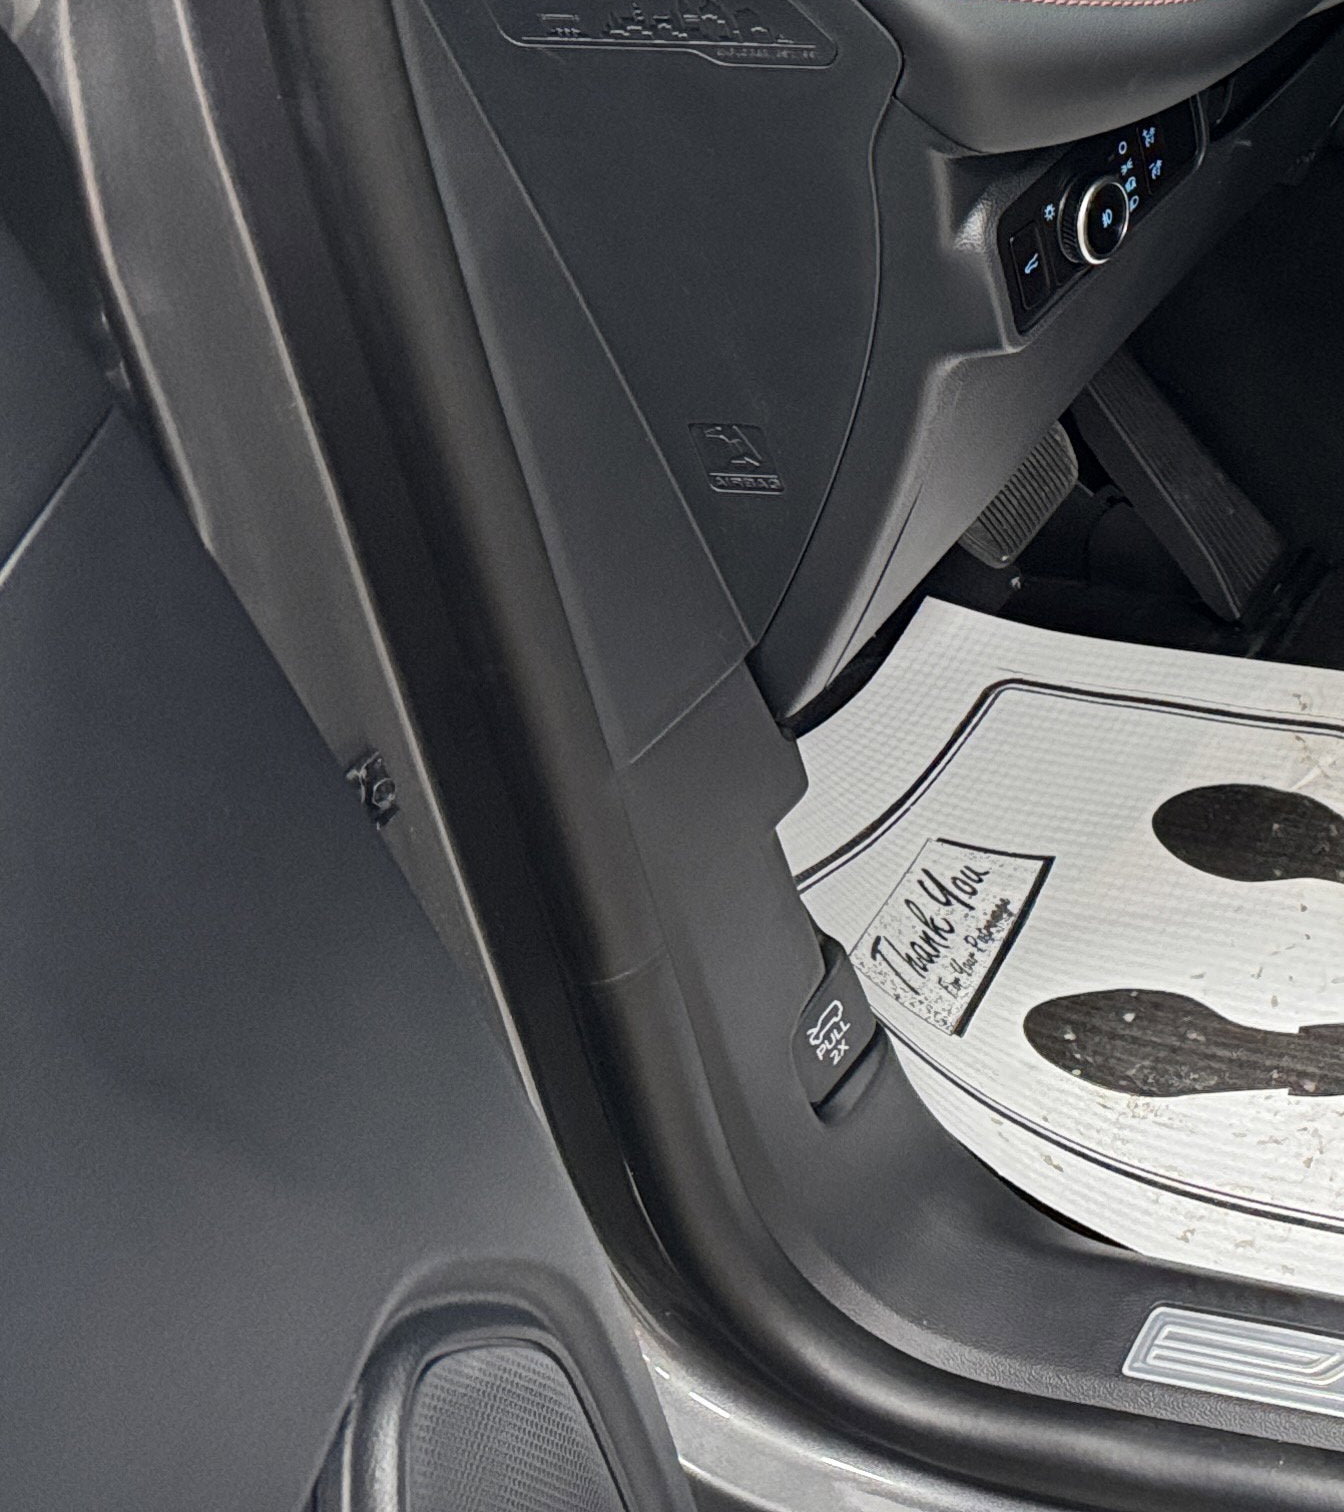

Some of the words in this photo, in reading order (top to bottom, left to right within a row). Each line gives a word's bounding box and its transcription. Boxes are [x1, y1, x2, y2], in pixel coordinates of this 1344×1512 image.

[870, 898, 955, 996] Thank
[917, 865, 990, 911] You
[950, 951, 978, 978] Your
[816, 1021, 851, 1061] PULL
[830, 1038, 850, 1065] 2X
